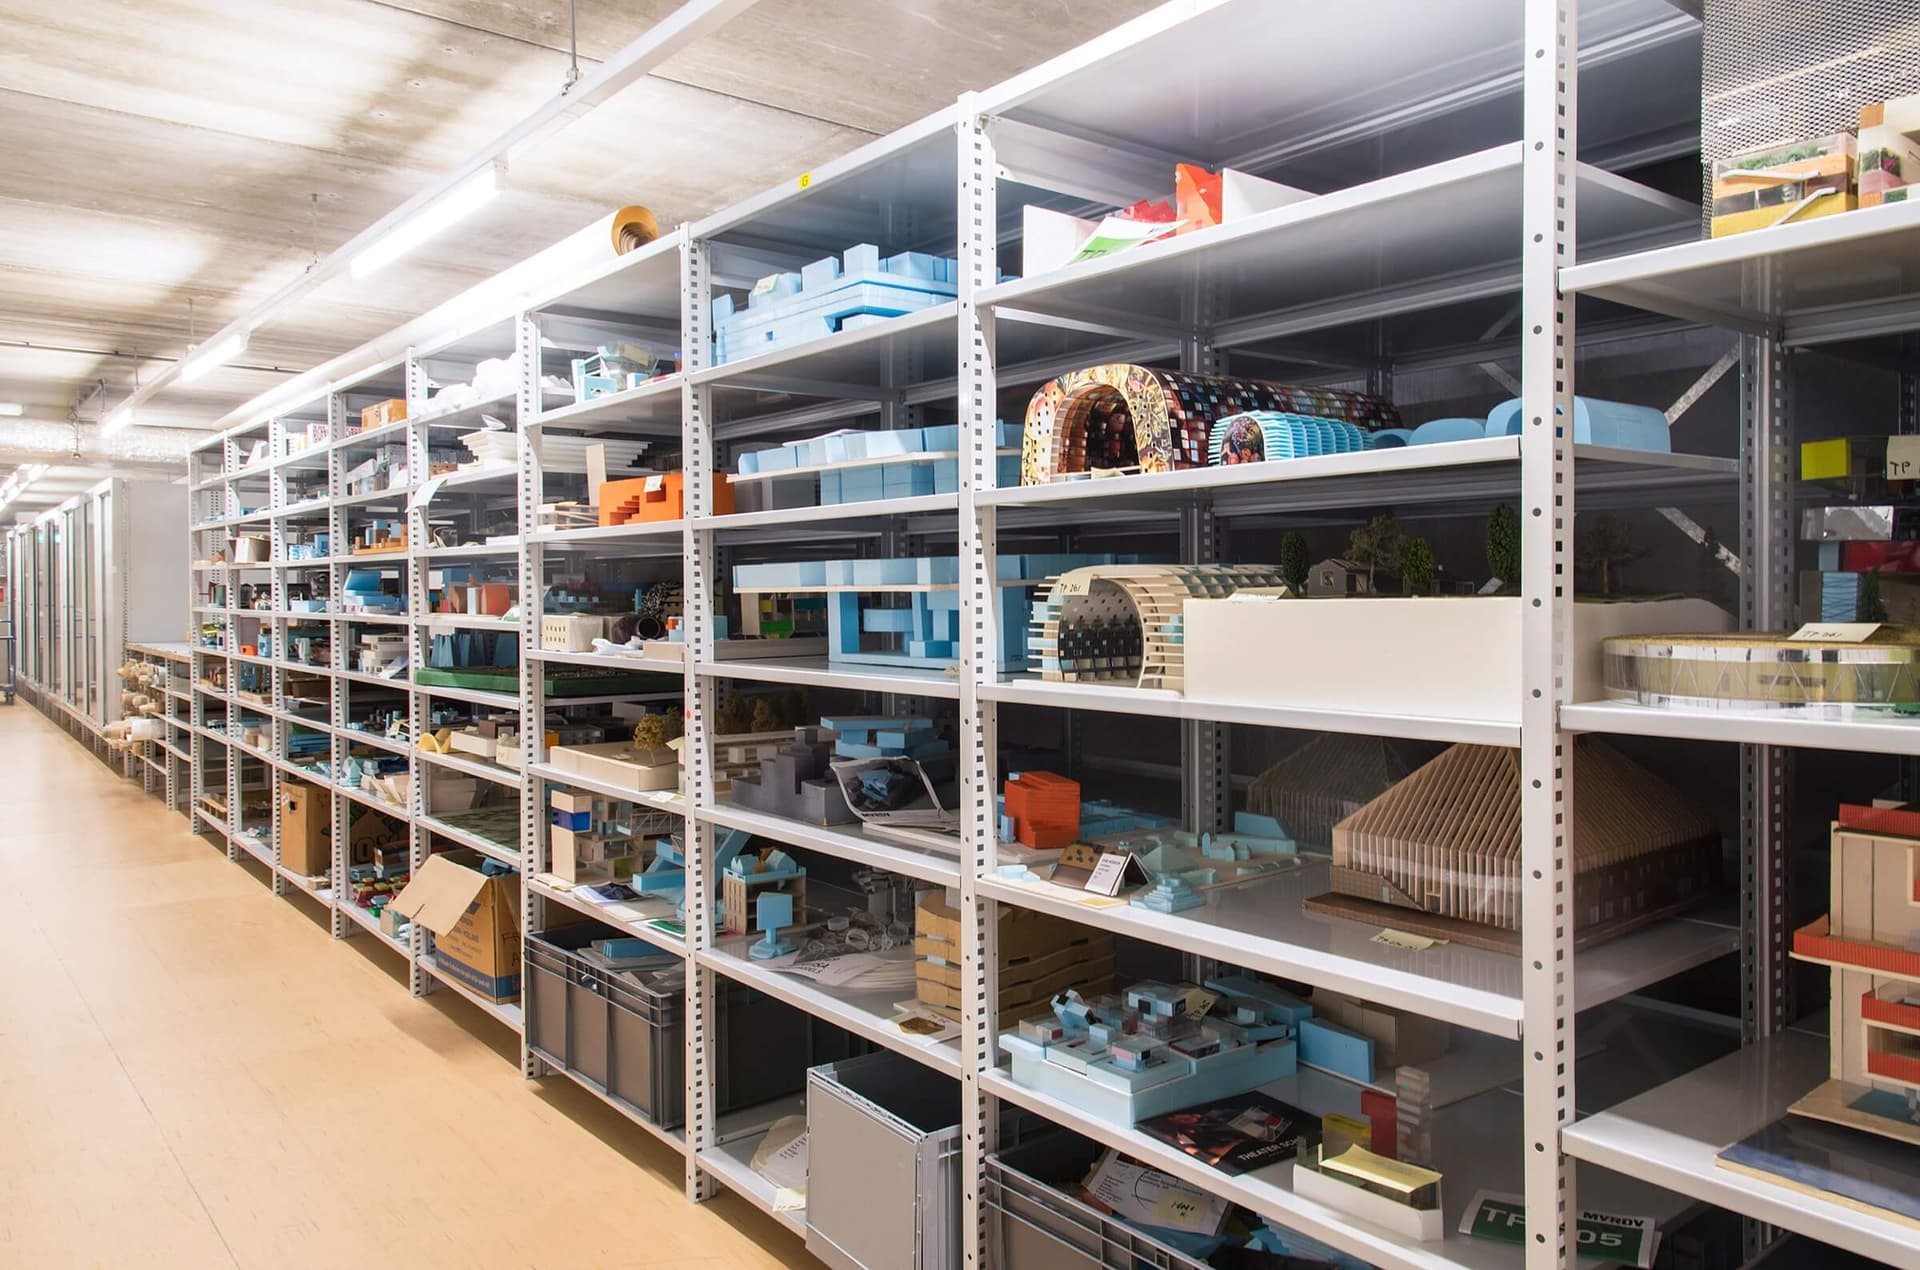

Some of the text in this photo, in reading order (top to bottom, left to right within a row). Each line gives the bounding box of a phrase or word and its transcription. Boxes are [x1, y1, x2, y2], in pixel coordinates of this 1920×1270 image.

[1889, 461, 1911, 476] TP
[1237, 1143, 1281, 1161] THEATER
[1583, 1211, 1645, 1228] MVRDV
